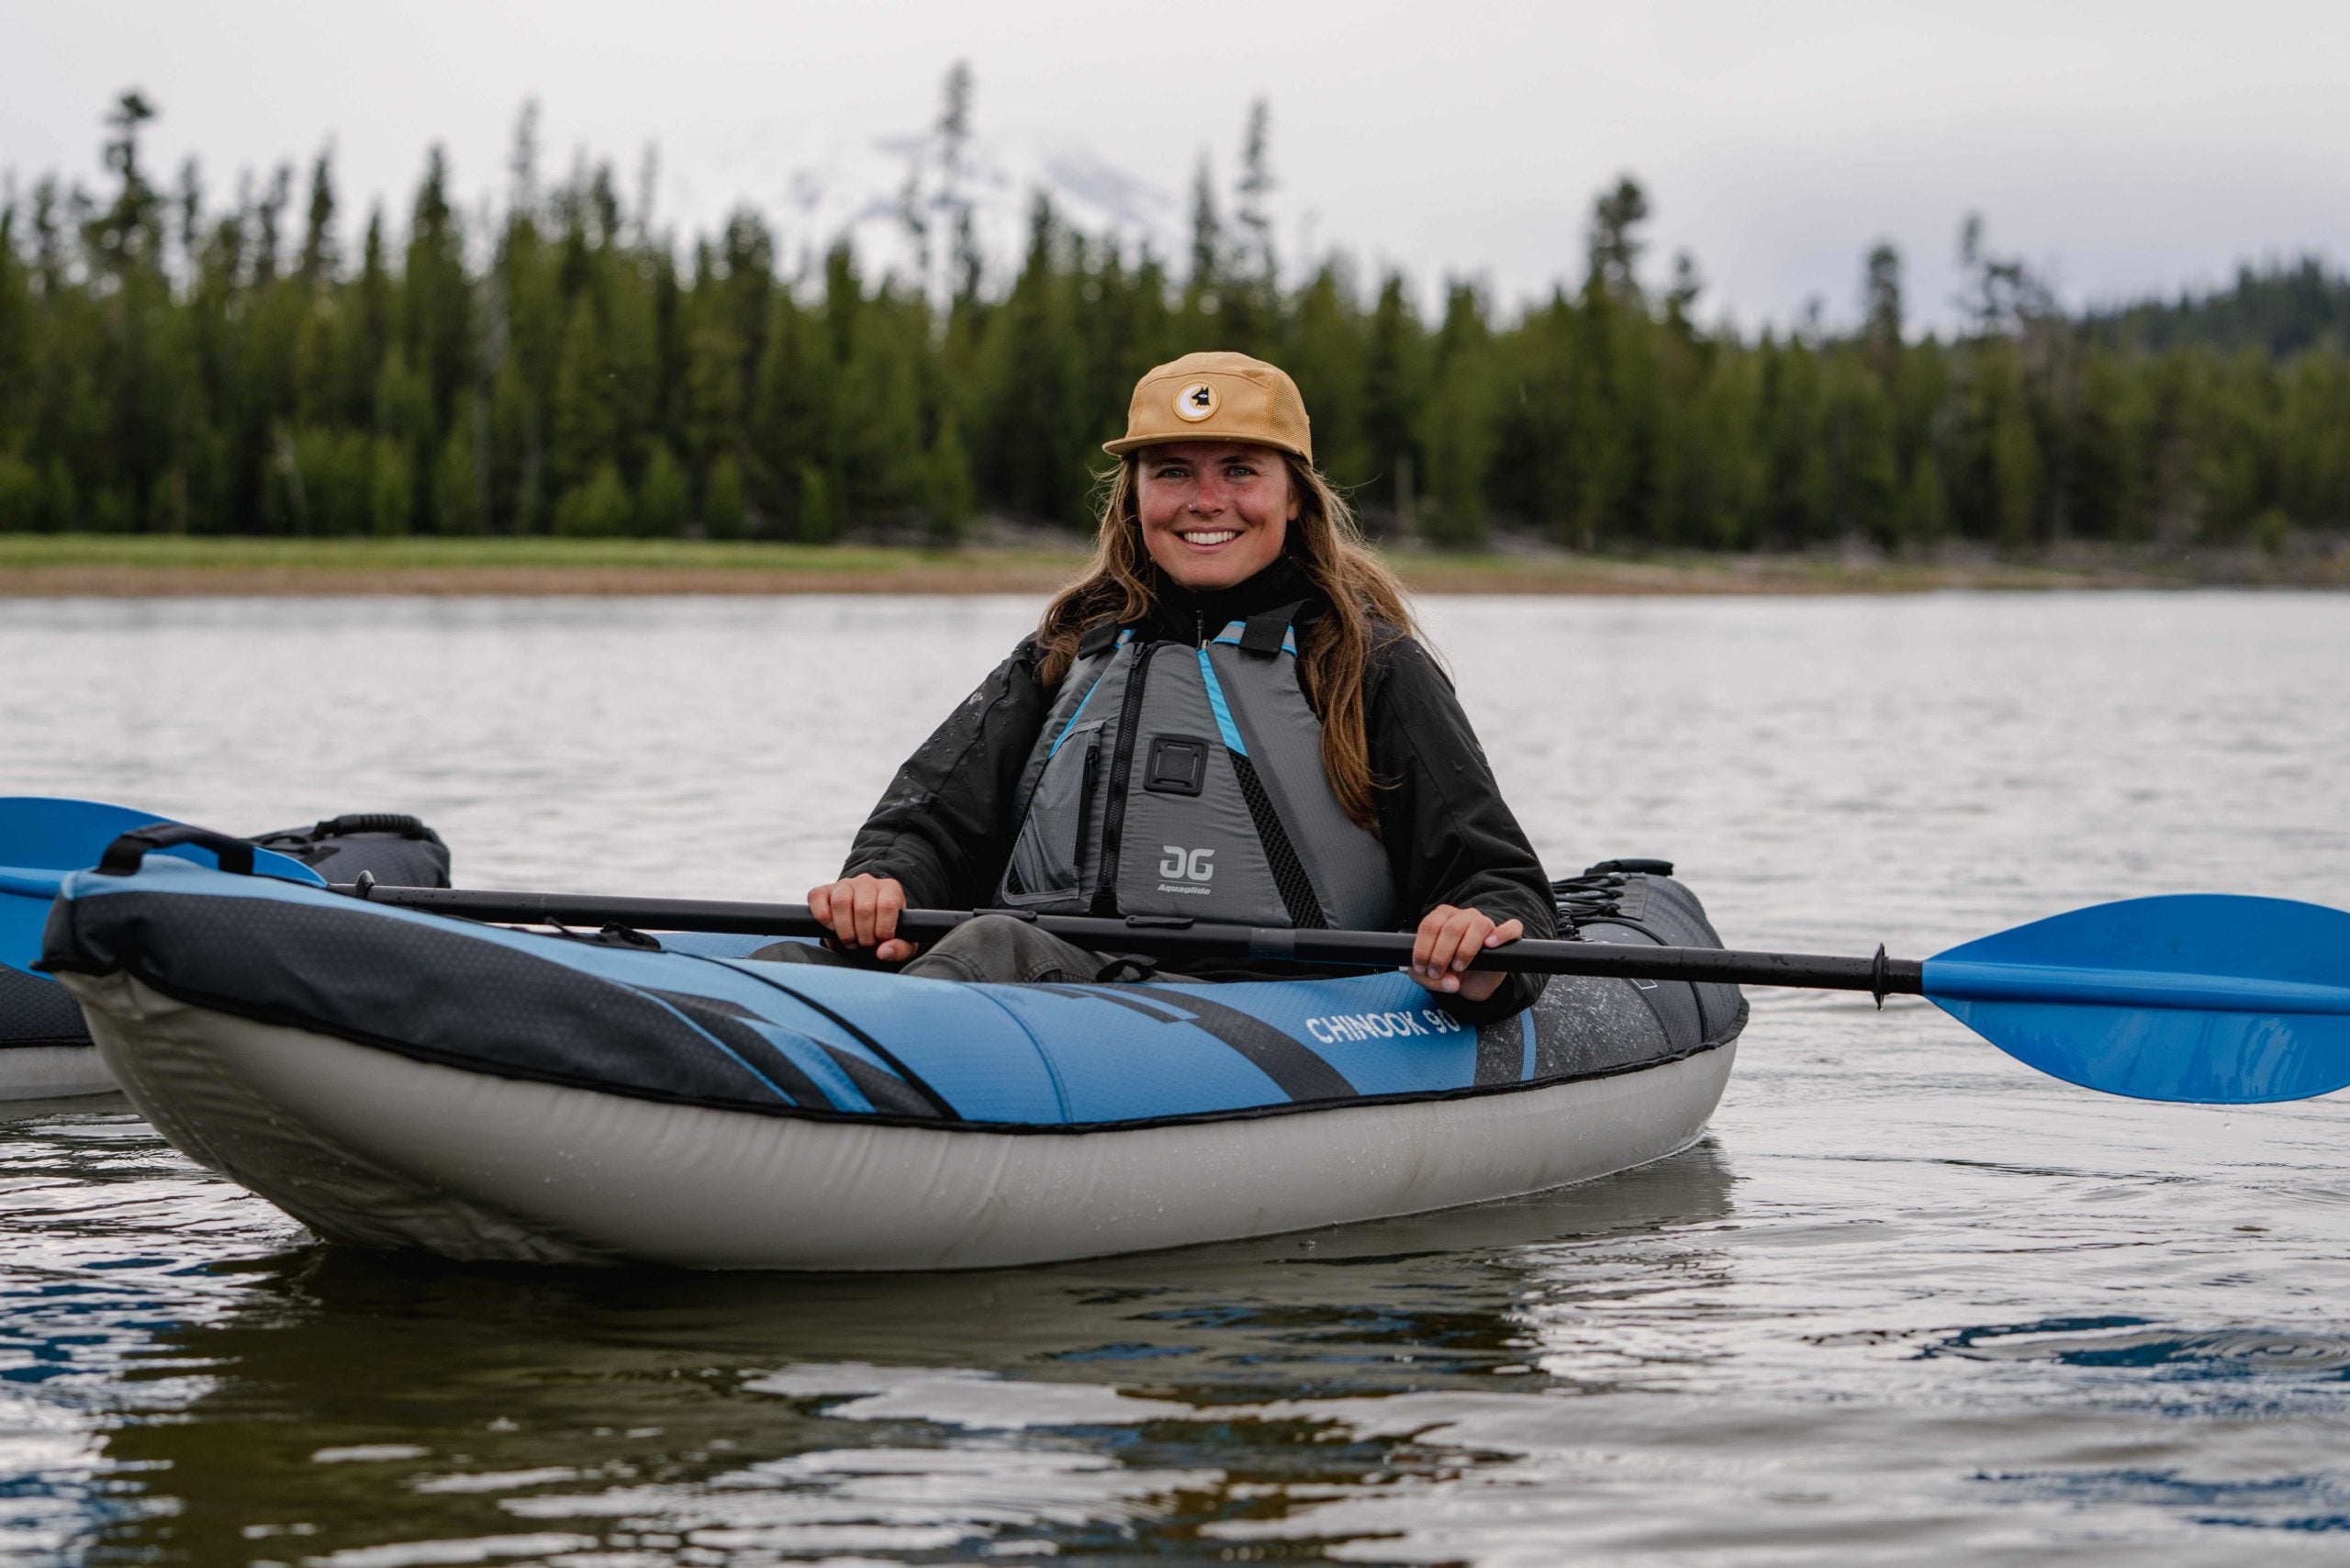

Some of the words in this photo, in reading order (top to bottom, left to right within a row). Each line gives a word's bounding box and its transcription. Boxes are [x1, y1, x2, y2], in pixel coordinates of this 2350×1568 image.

[1158, 884, 1212, 895] Aquaglide
[1305, 1011, 1429, 1044] CHINOOK
[1422, 1008, 1461, 1034] 90
